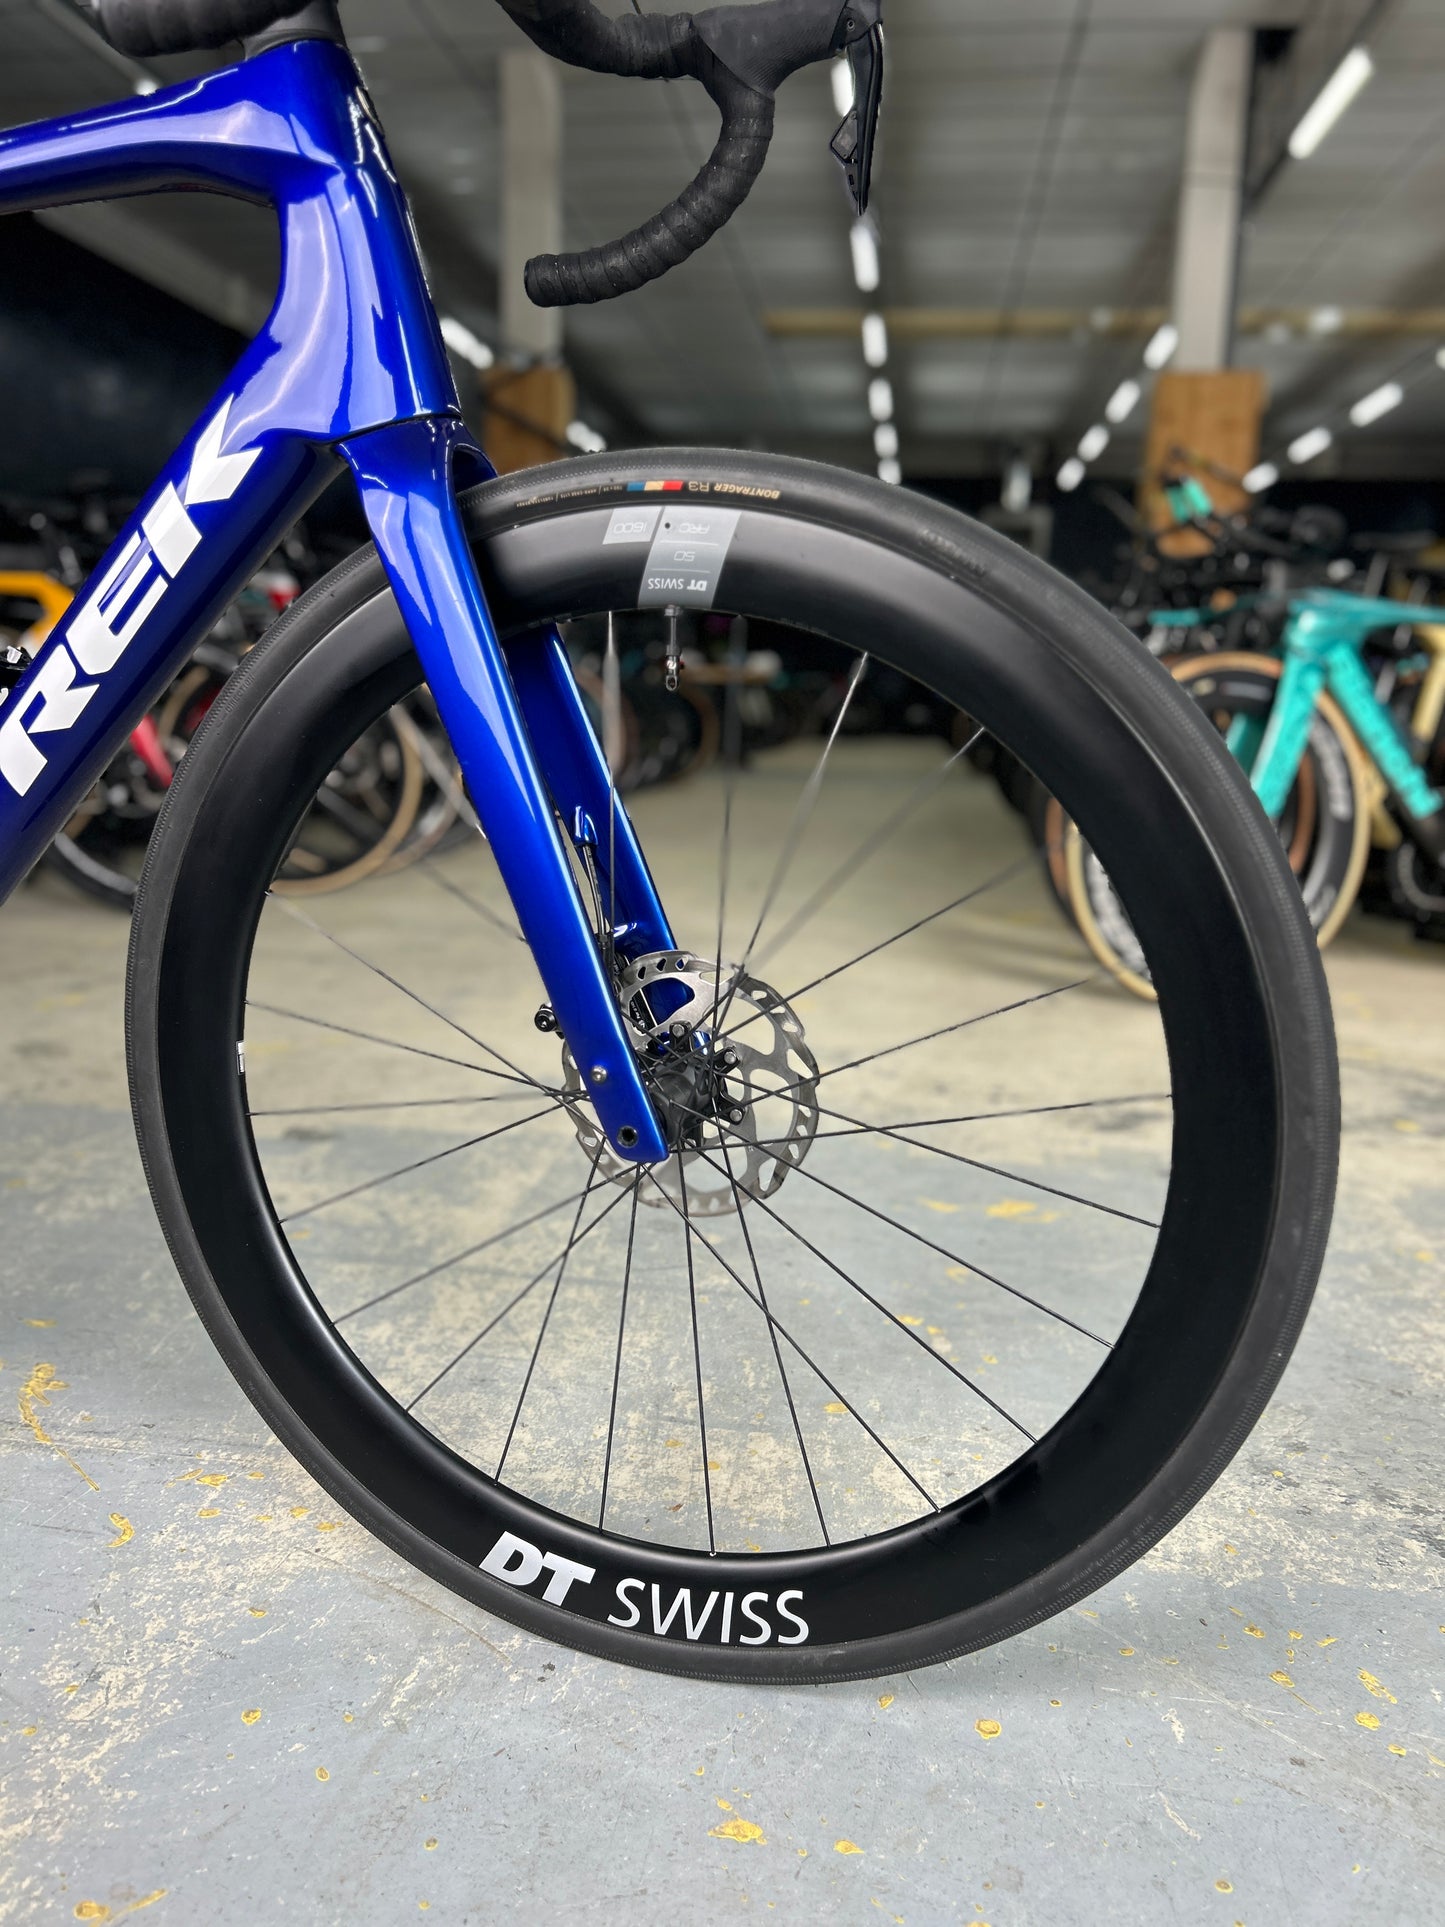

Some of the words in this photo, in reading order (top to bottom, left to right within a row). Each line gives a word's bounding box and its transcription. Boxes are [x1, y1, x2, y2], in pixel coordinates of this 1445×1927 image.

[688, 480, 710, 492] R3
[714, 482, 780, 499] BONTRAGER
[647, 578, 685, 590] SWISS
[686, 579, 708, 592] DT
[478, 1531, 597, 1607] DT
[607, 1577, 810, 1645] SWISS
